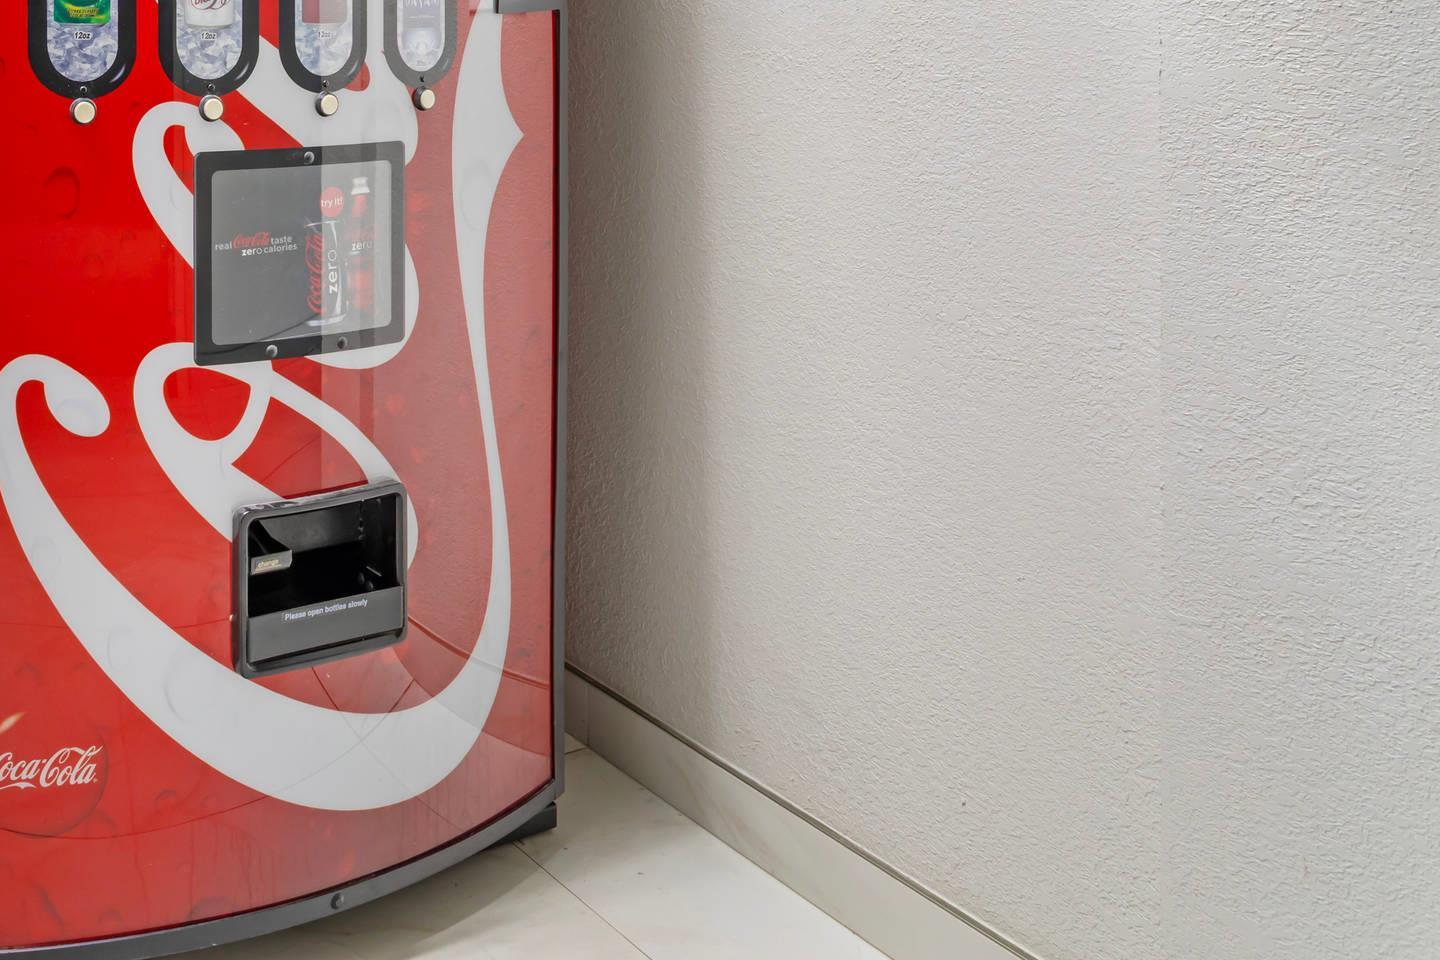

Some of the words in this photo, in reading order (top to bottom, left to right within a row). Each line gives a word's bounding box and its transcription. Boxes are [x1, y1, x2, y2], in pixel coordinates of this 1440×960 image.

[74, 31, 92, 40] 12oz
[201, 31, 217, 40] 12oz
[320, 198, 333, 209] try
[214, 241, 233, 251] real
[271, 236, 293, 246] taste
[241, 247, 263, 257] zero
[263, 242, 298, 254] calories
[327, 249, 338, 295] zero
[284, 610, 307, 622] Please
[307, 607, 324, 618] open
[324, 602, 347, 613] bottles
[347, 598, 369, 609] slowly
